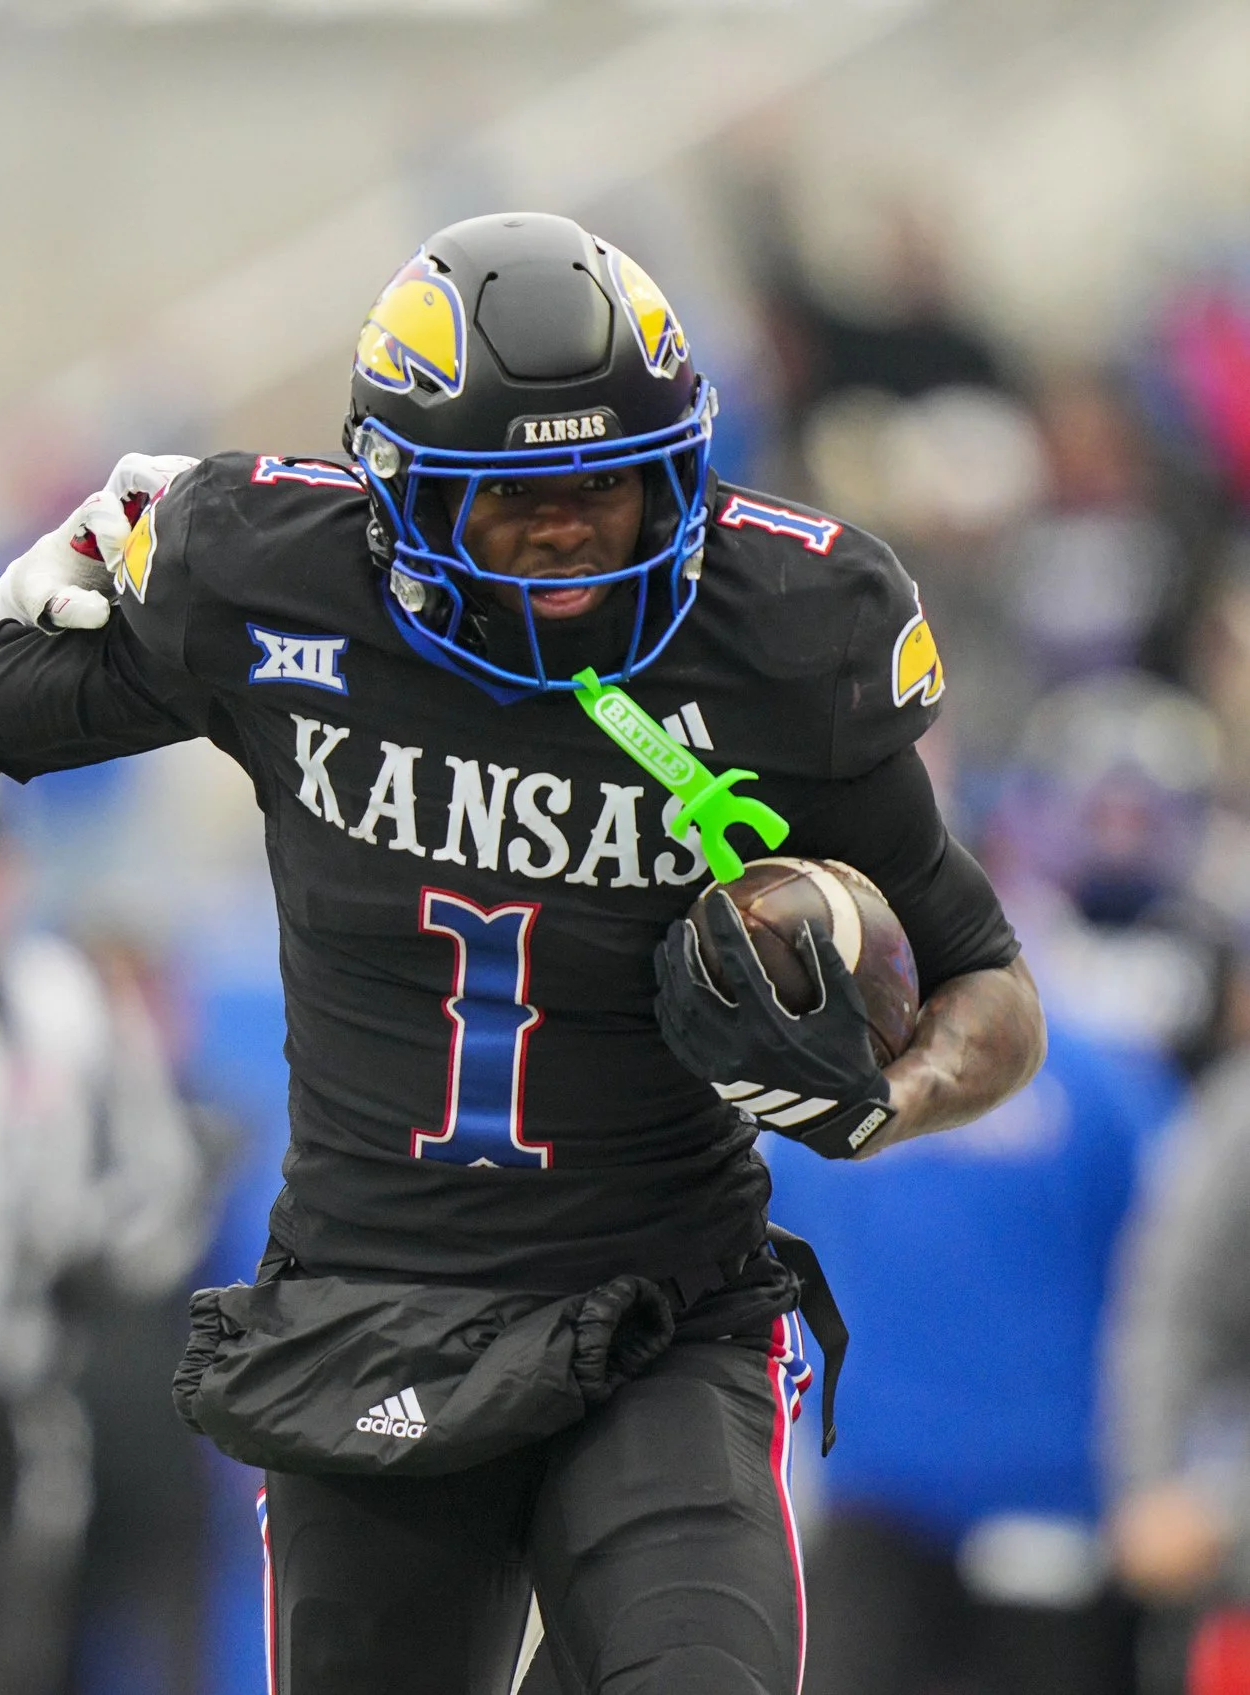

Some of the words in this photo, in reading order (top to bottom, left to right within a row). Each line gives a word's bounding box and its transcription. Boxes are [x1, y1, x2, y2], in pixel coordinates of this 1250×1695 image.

[523, 415, 607, 444] KANSAS
[718, 495, 842, 556] 1
[252, 630, 348, 691] XII
[601, 700, 687, 779] BATTLE
[289, 713, 712, 888] KANSAS
[411, 888, 553, 1169] 1
[356, 1415, 428, 1439] adida
